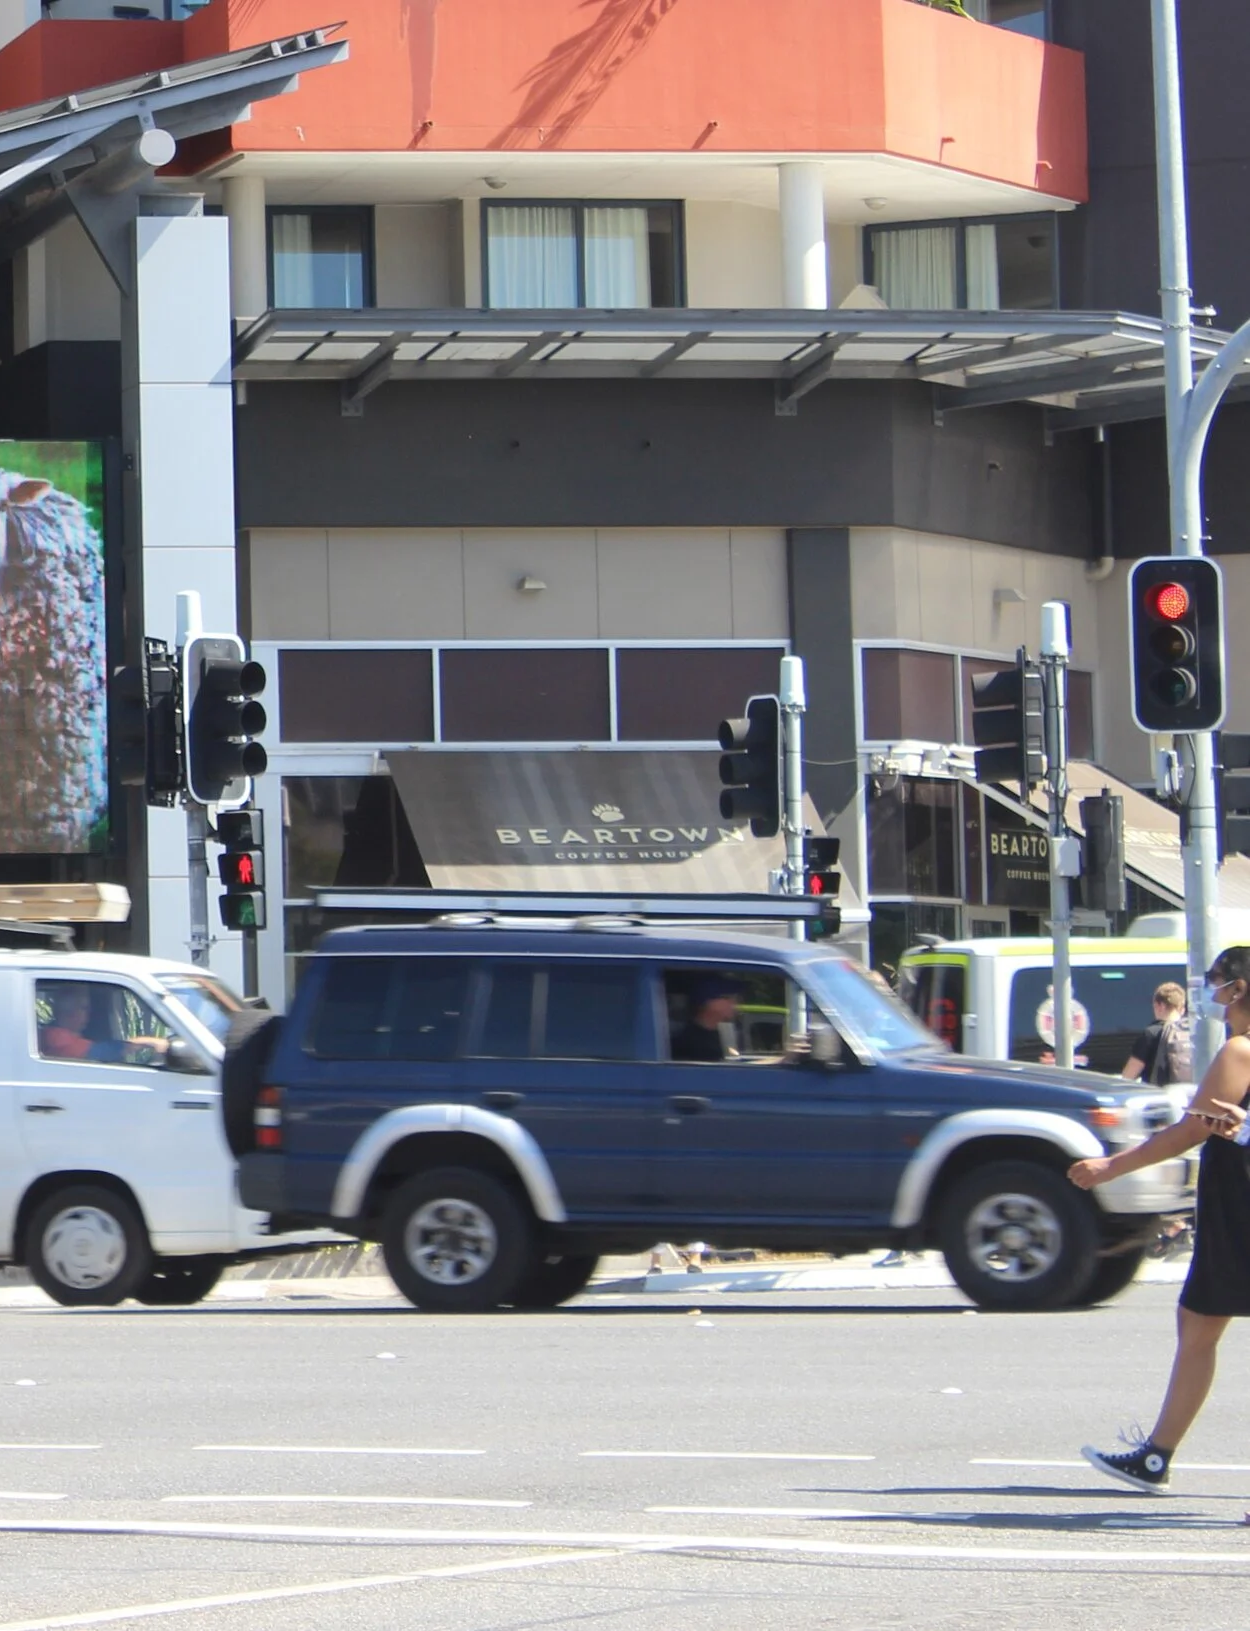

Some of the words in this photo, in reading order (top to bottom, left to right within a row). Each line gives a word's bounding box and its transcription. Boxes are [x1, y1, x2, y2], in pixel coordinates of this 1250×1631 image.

[497, 827, 745, 844] BEARTOWN
[990, 833, 1048, 858] BEARTO
[555, 852, 629, 860] COFFEE
[639, 851, 702, 859] HOUSE
[1006, 869, 1032, 880] COFFEE
[1033, 872, 1050, 882] HOUS
